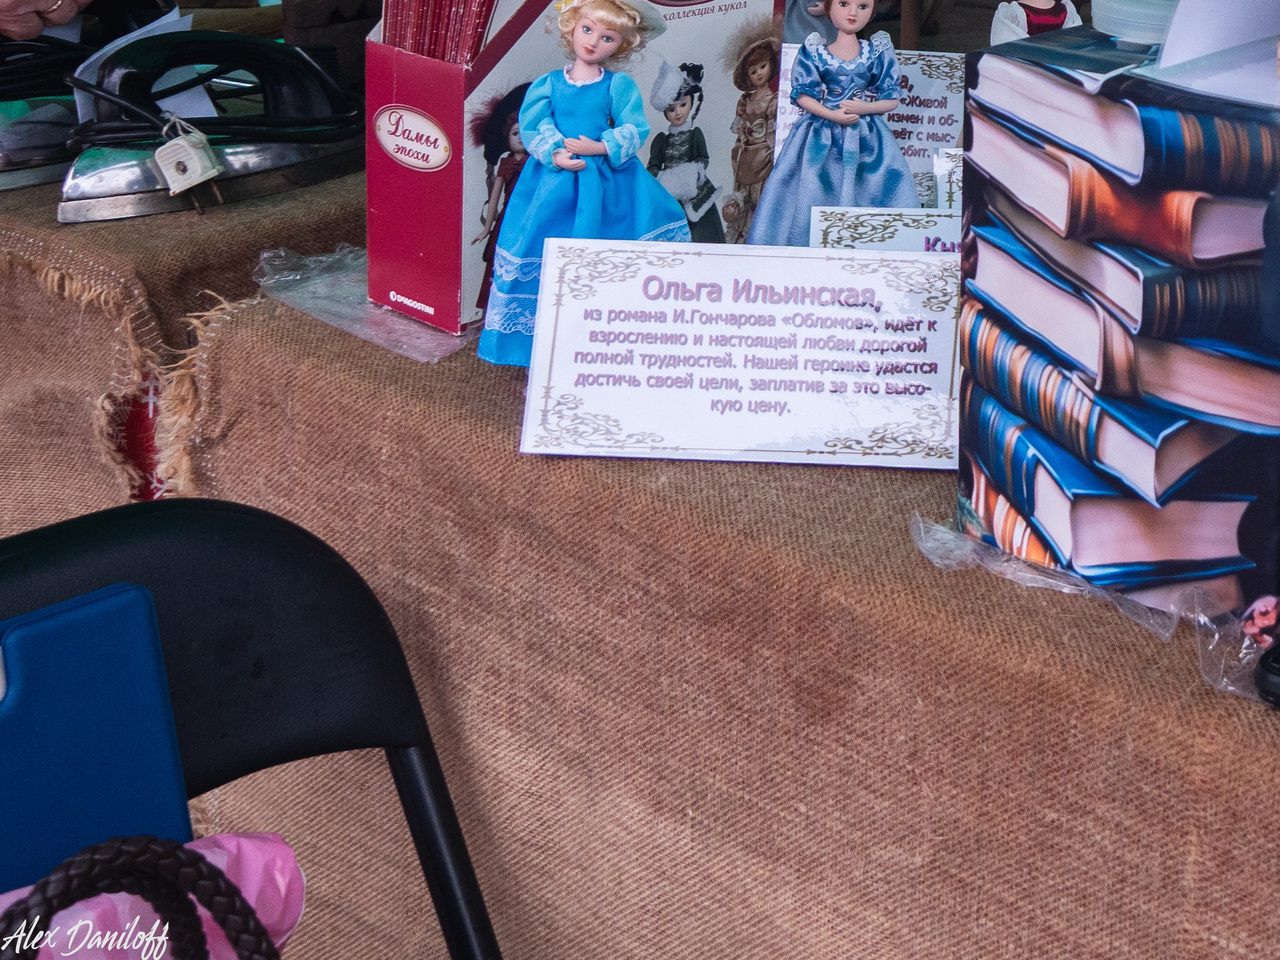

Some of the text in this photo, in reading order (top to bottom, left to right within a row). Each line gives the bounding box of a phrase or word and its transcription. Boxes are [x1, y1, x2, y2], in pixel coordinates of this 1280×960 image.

[663, 0, 747, 21] коллекция кукол
[387, 110, 440, 150] Дамы
[887, 112, 958, 126] измен и об-
[893, 128, 912, 140] вёт
[916, 131, 923, 141] с
[393, 143, 431, 164] эпохи
[642, 274, 884, 312] Ольга Ильинская,
[583, 308, 937, 335] из романа И.Гончарова «Обломов», идёт к
[589, 328, 927, 355] взрослению и настоящей любви дорогой
[574, 348, 938, 377] полной трудностей. Нашей героине удастся
[574, 370, 931, 396] достичь своей цели, заплатив за это высо-
[711, 397, 791, 416] кую цену.
